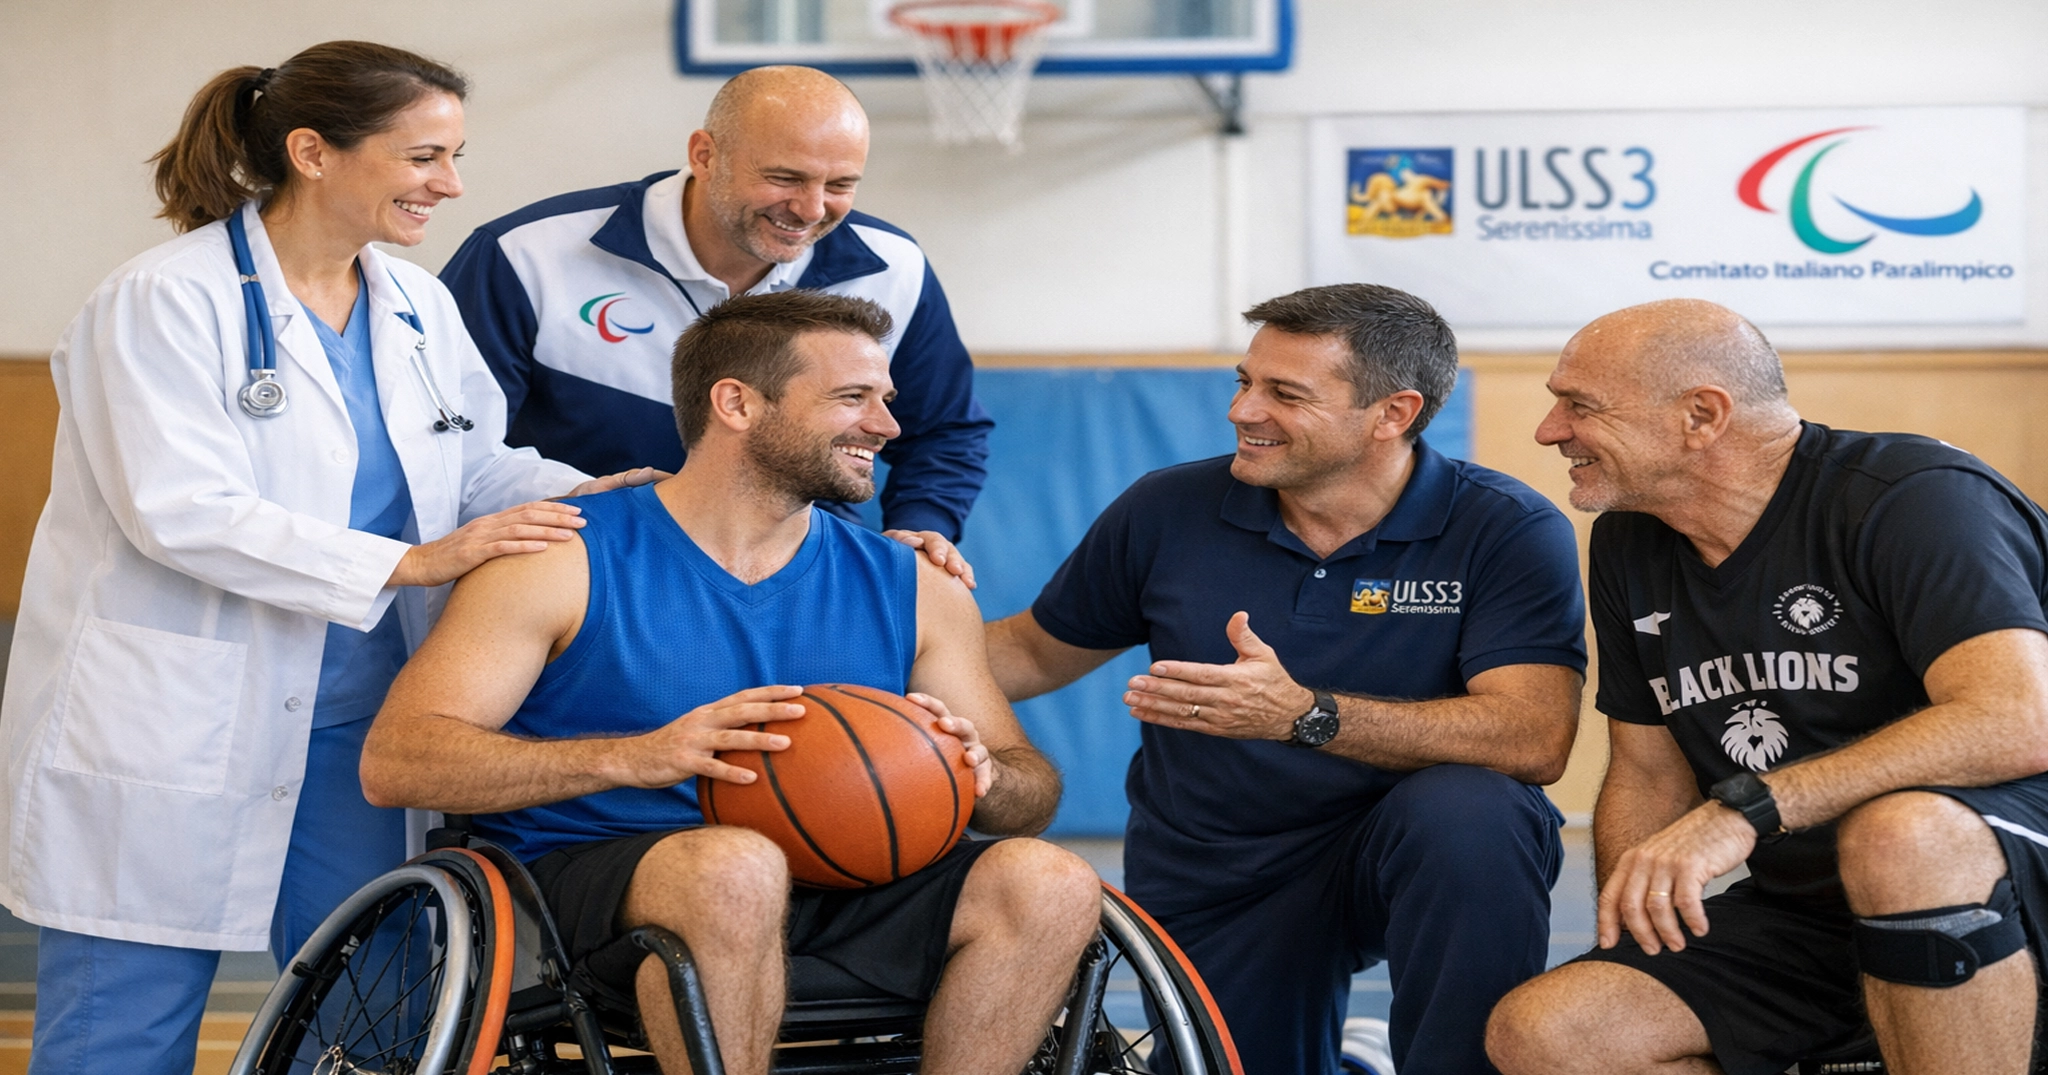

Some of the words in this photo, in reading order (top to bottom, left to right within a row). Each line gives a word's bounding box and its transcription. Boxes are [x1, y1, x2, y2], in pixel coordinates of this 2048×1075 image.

[1475, 147, 1656, 211] ULSS3
[1476, 214, 1654, 241] Serenissima
[1649, 260, 1769, 280] Comitato
[1773, 260, 1865, 280] Italiano
[1871, 260, 2014, 282] Paralimpico
[1392, 580, 1463, 604] ULSS3
[1743, 651, 1860, 692] LIONS
